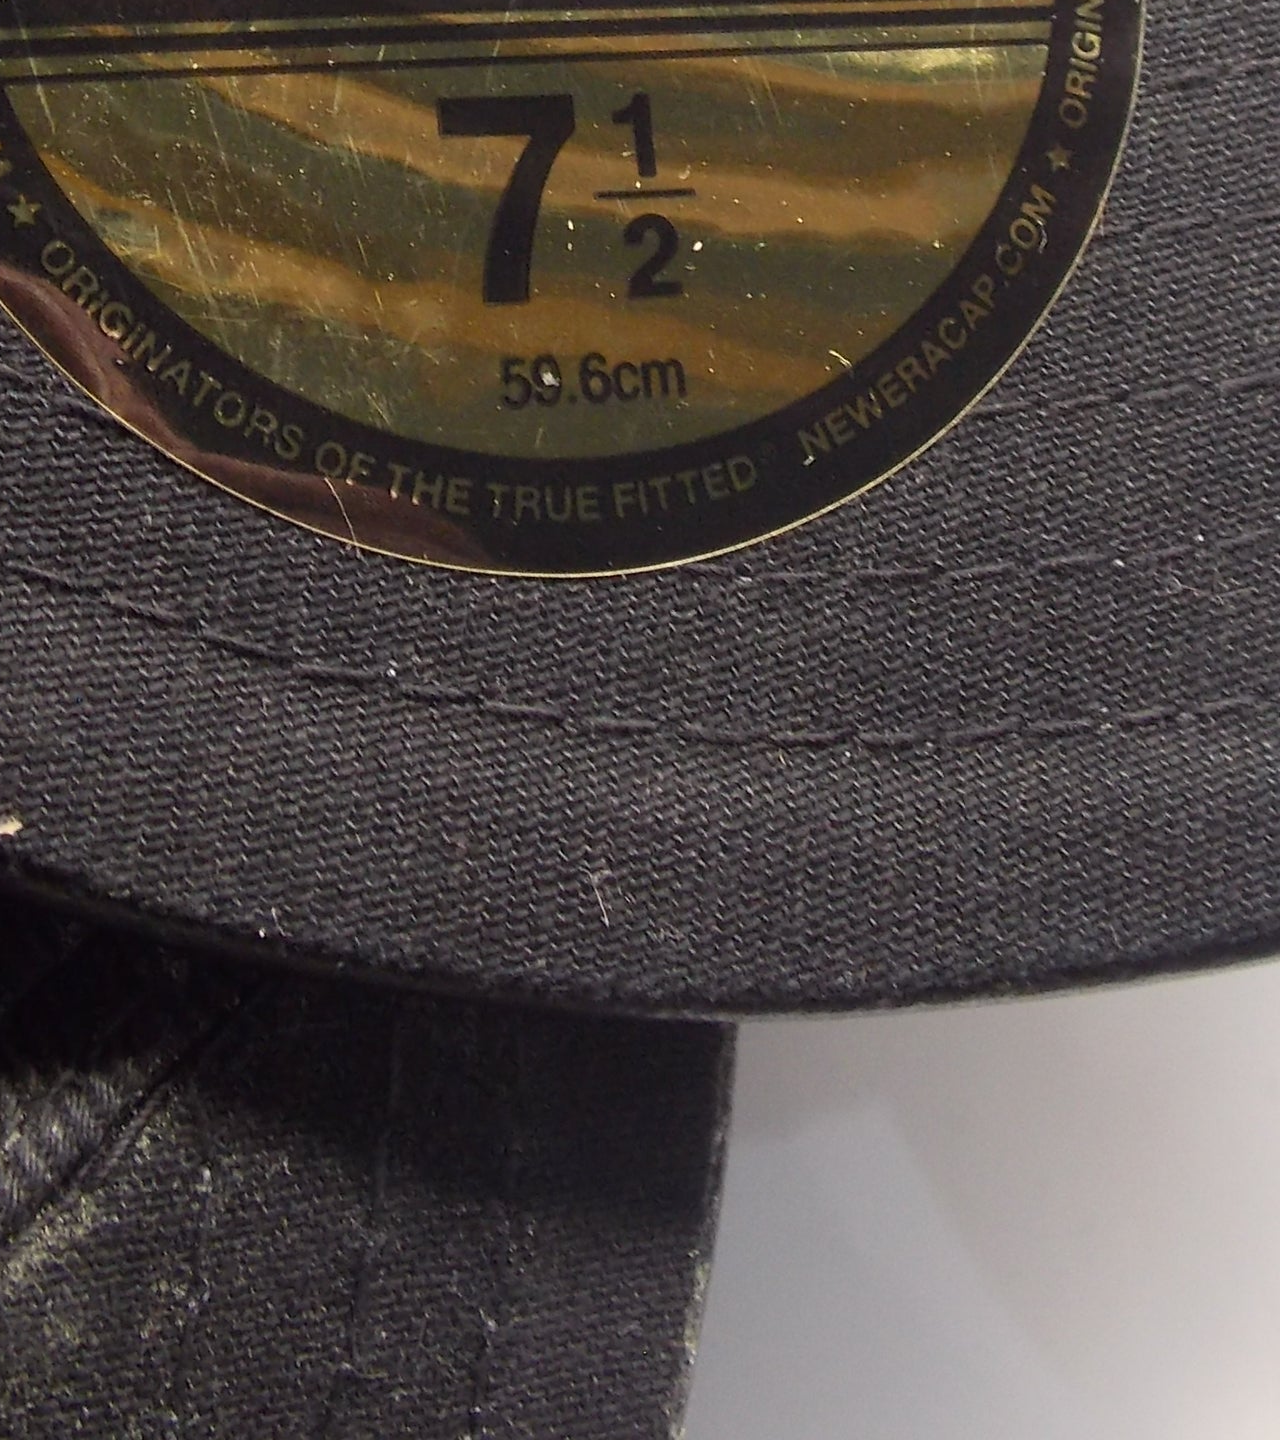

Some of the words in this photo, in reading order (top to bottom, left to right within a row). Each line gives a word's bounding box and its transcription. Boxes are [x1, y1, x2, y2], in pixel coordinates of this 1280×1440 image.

[437, 94, 577, 304] 7
[797, 180, 1061, 462] NEWERACAP.COM
[40, 239, 306, 461] ORIGINATORS
[314, 441, 375, 486] OF
[387, 463, 471, 515] THE
[490, 482, 601, 523] TRUE
[612, 453, 759, 519] FITTED
[498, 350, 689, 411] 59.6cm
